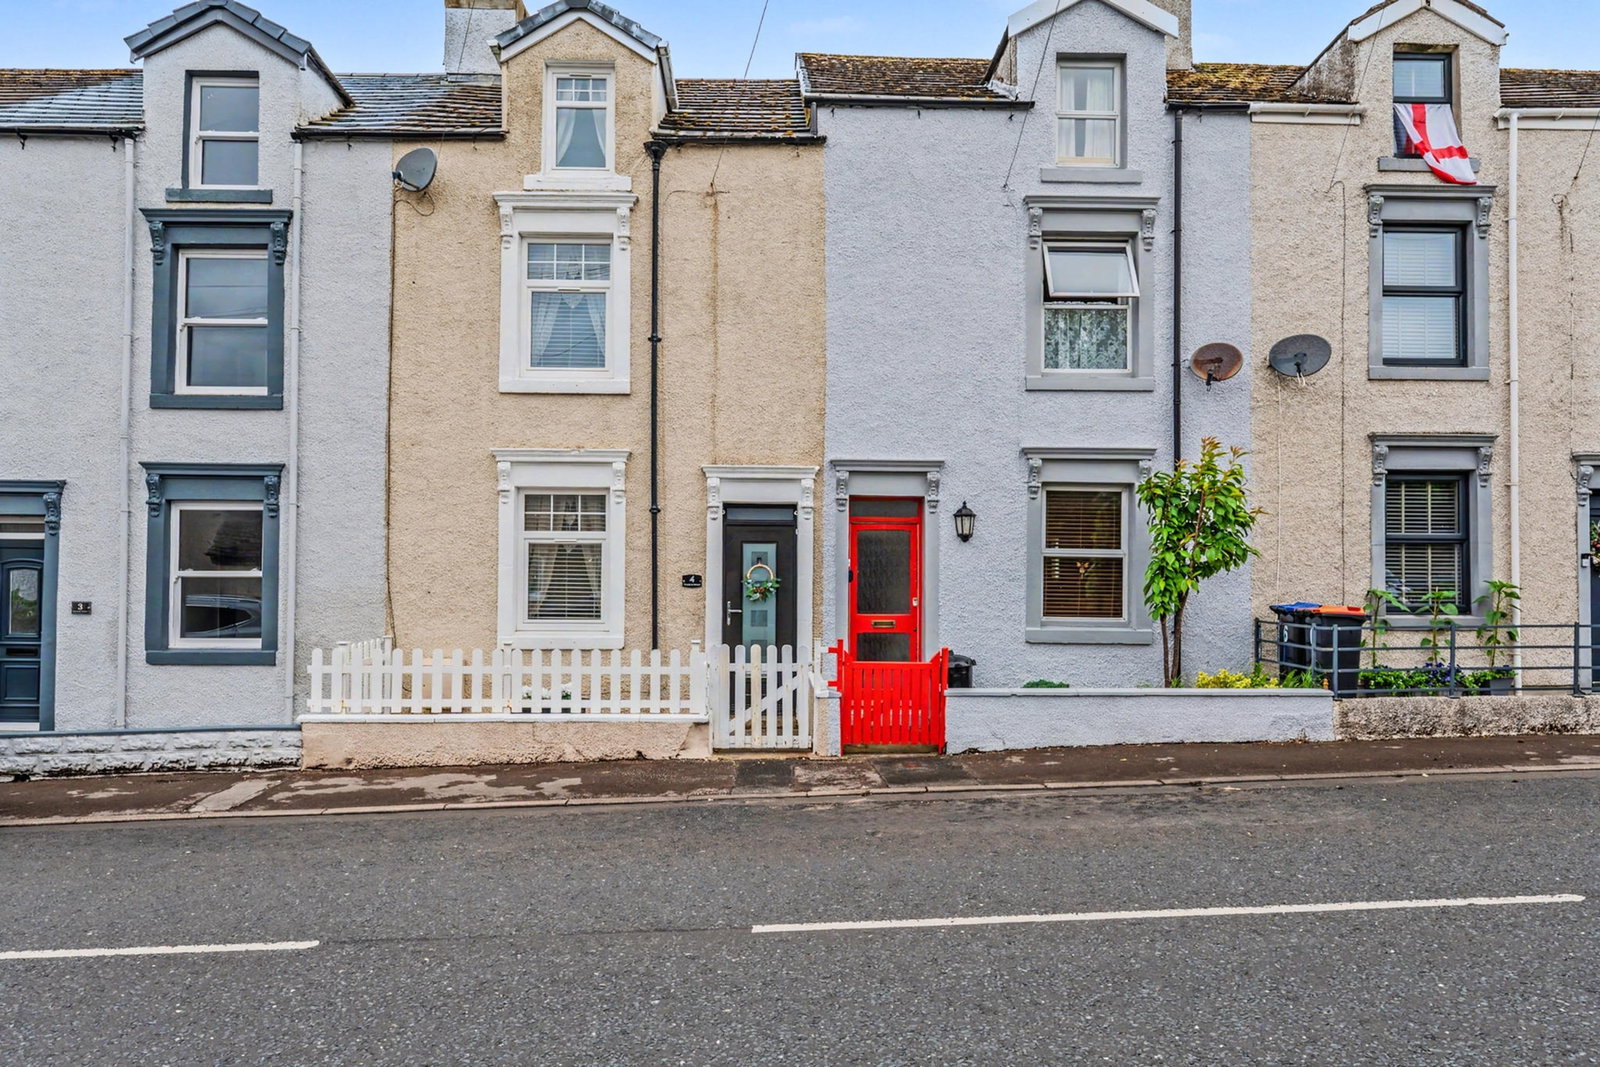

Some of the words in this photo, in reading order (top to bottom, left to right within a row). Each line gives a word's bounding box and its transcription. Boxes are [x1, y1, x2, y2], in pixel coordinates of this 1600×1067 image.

[689, 575, 695, 583] 4
[77, 602, 83, 610] 3
[1283, 624, 1289, 643] 6
